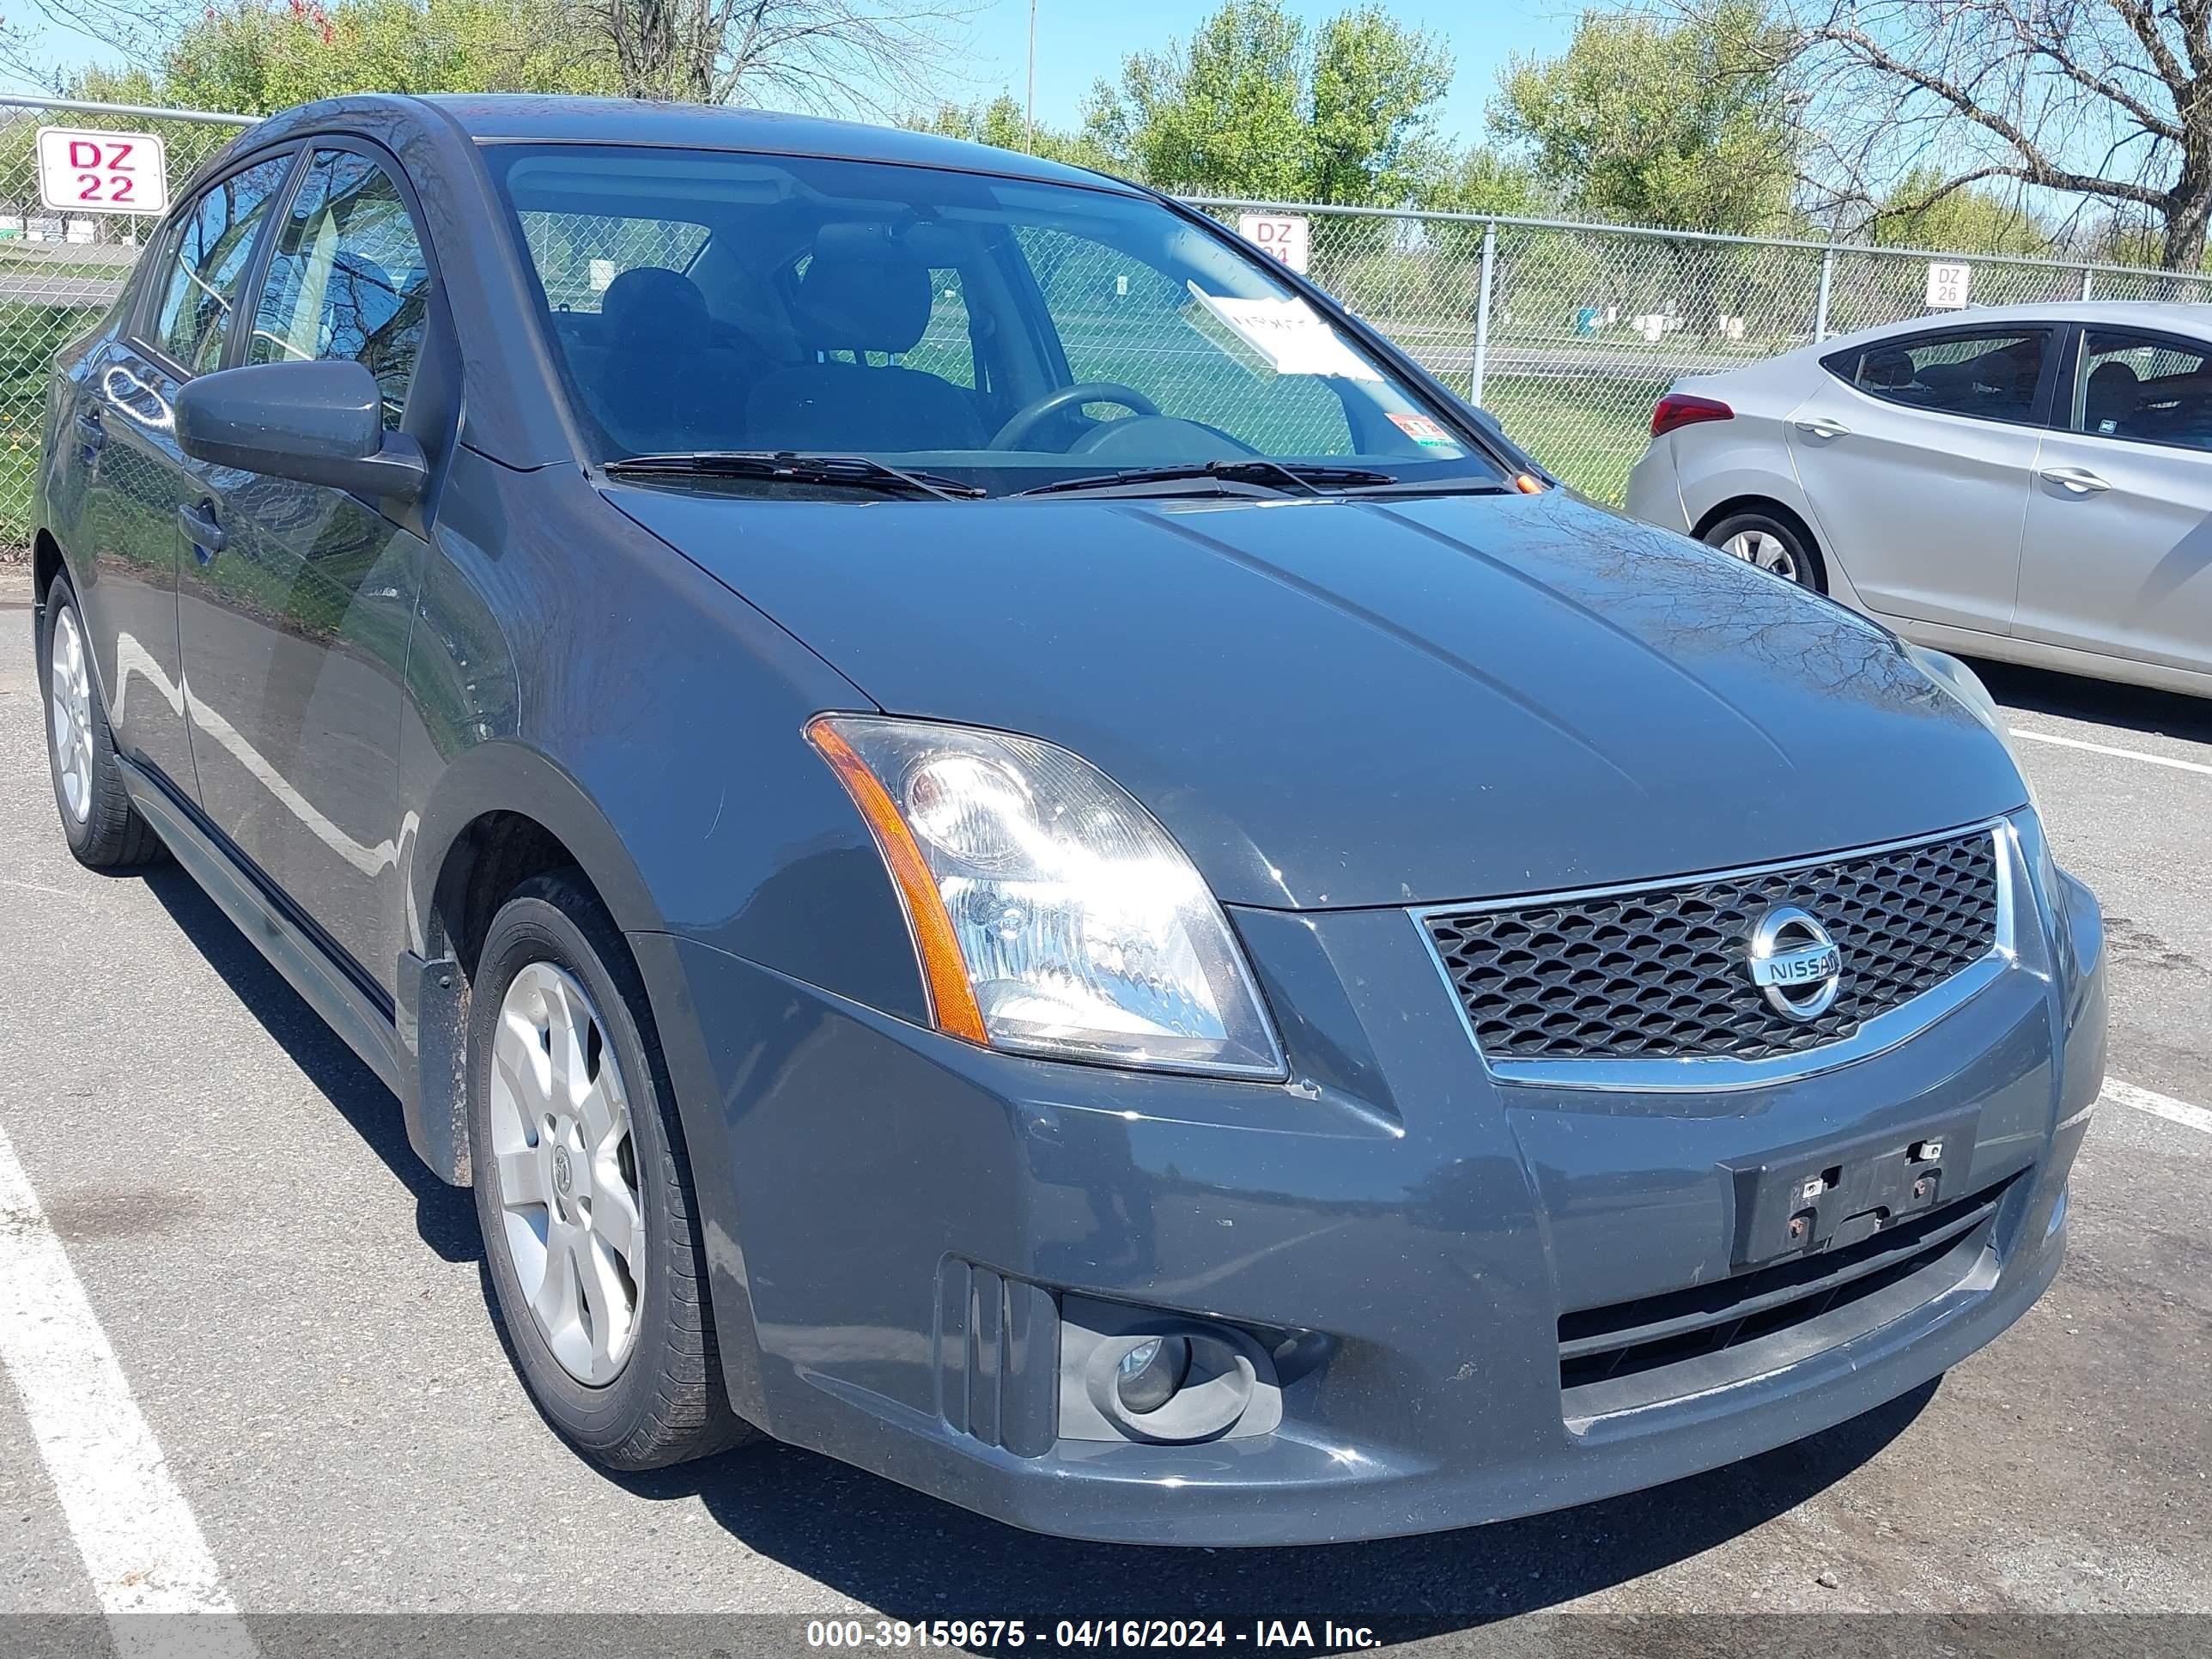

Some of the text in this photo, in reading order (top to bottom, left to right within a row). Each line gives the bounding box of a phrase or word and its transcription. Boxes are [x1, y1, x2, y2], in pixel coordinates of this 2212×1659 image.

[69, 141, 136, 171] DZ
[77, 173, 136, 202] 22
[1257, 222, 1292, 243] DZ
[1939, 268, 1960, 284] DZ
[1938, 286, 1957, 301] 26
[1769, 950, 1840, 980] NISSAN
